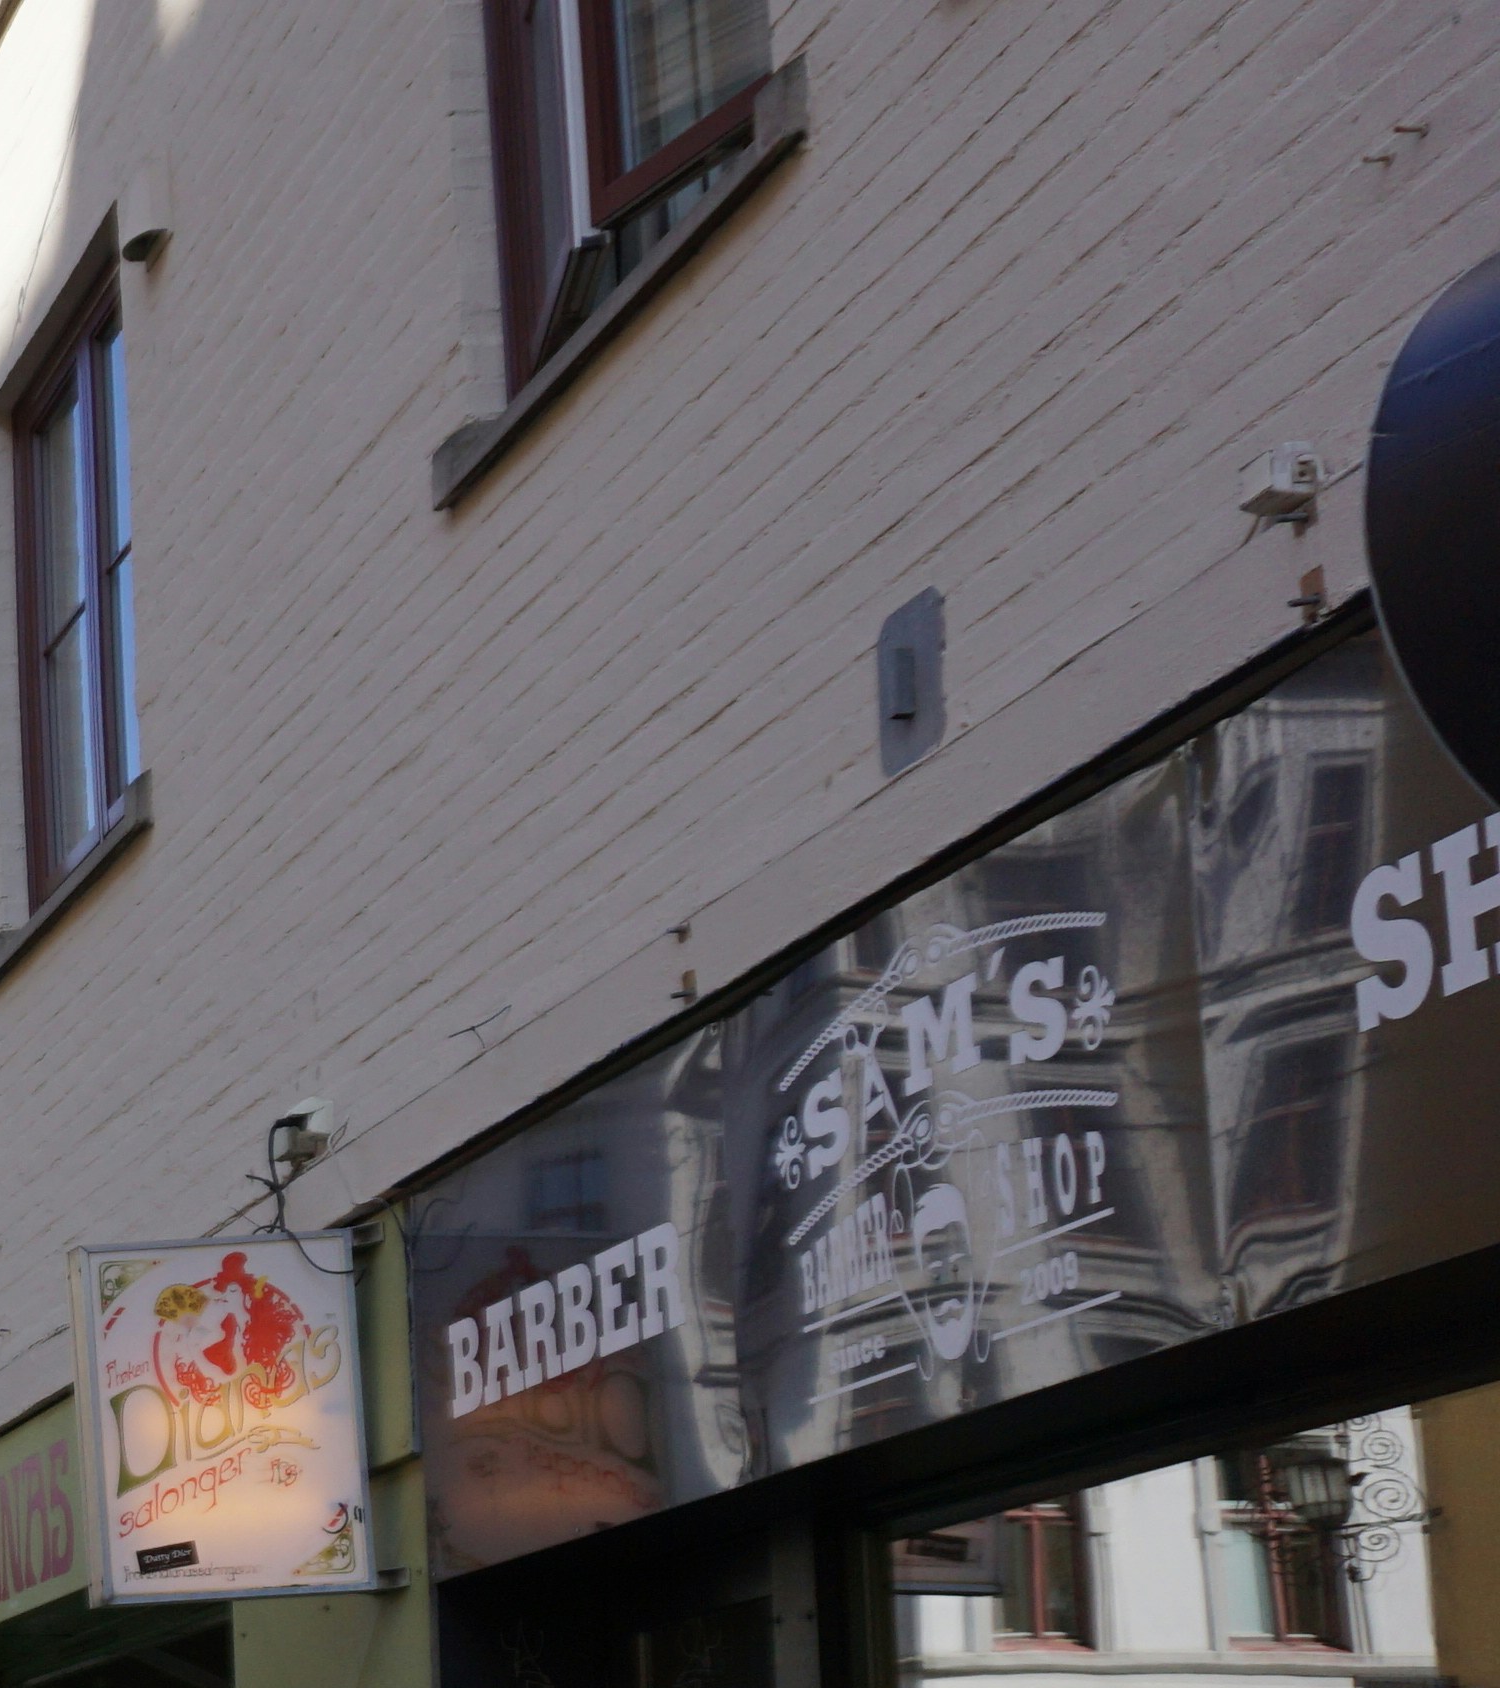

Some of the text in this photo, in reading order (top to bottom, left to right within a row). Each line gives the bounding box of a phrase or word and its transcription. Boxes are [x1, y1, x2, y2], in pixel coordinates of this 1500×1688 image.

[801, 1130, 1106, 1316] BARBER SHOP
[448, 1221, 686, 1419] BARBER
[830, 1250, 1080, 1374] since 2009
[109, 1324, 342, 1499] Dianas
[118, 1446, 253, 1538] salonger
